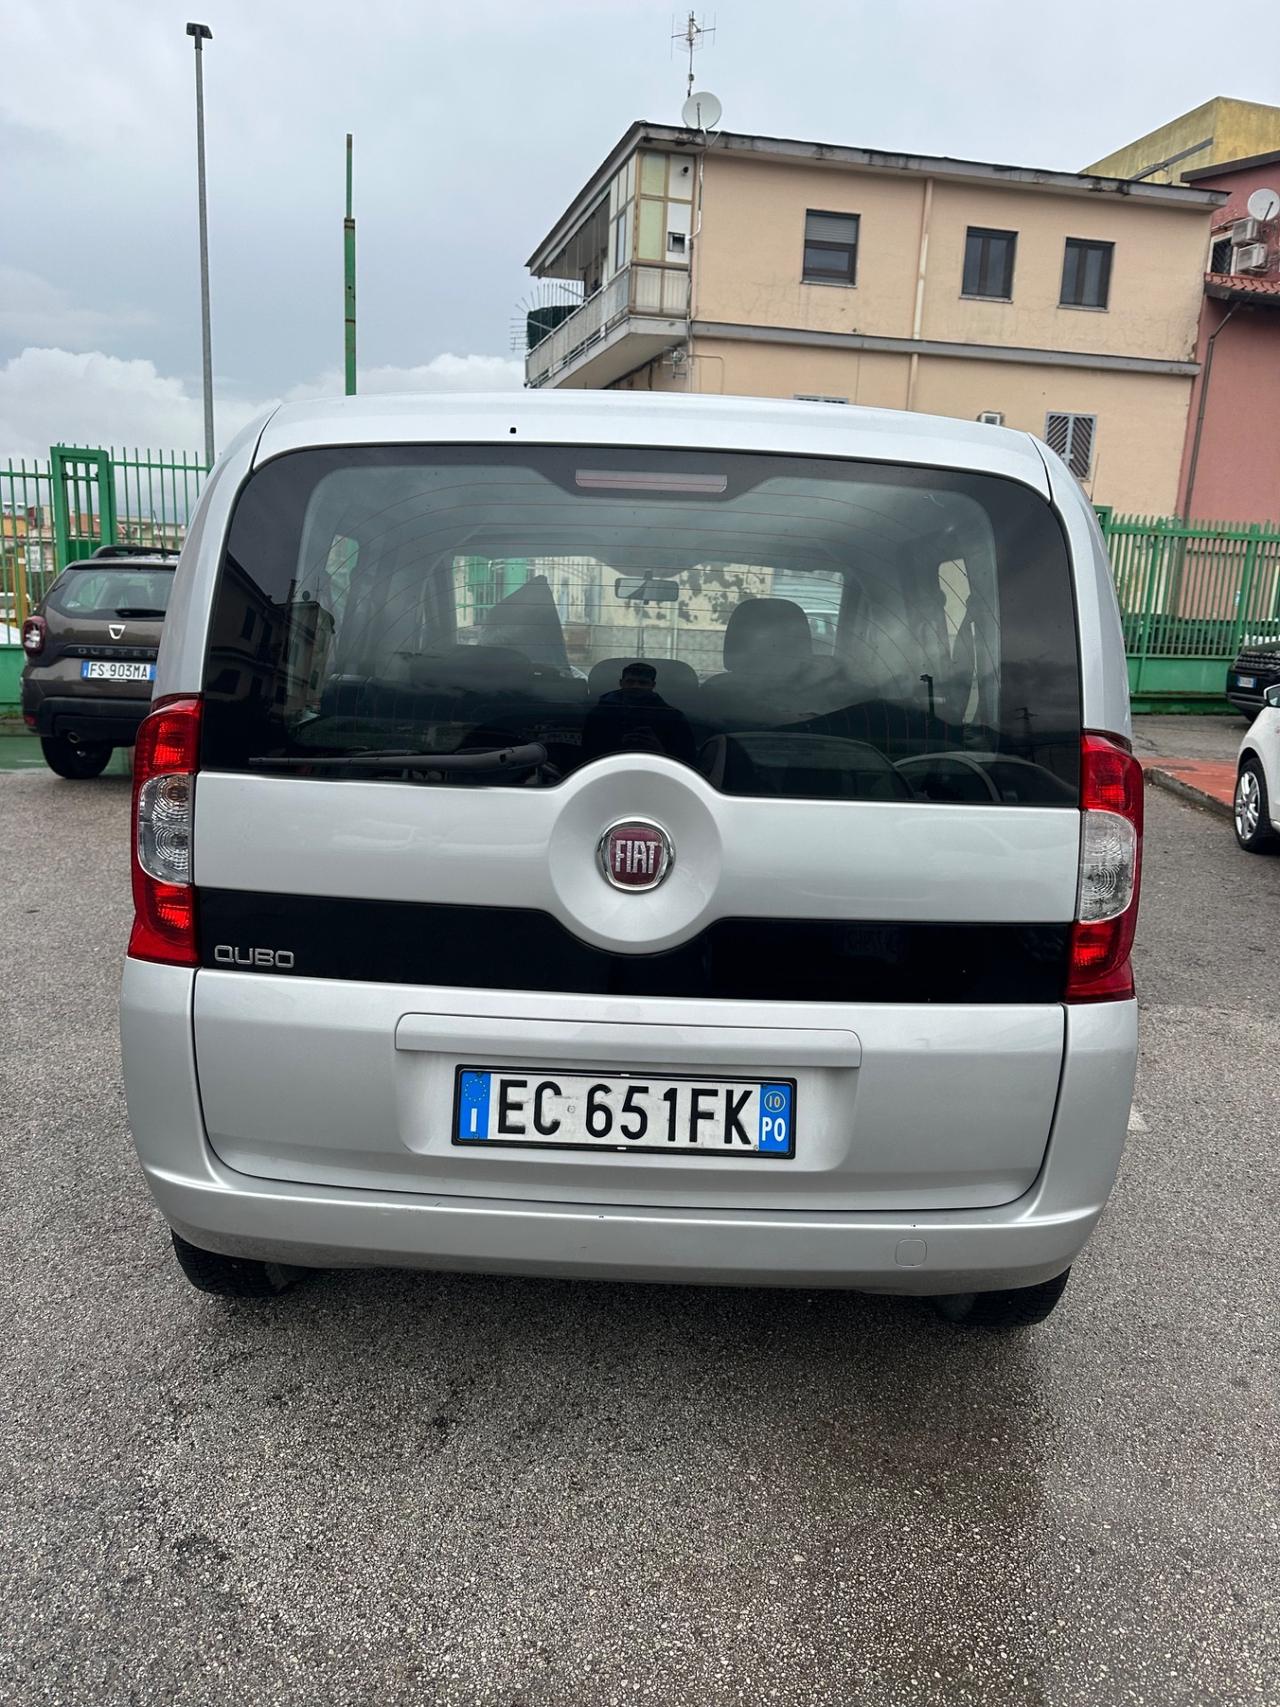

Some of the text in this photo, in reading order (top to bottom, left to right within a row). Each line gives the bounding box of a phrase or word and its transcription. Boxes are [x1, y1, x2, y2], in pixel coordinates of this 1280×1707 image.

[90, 664, 105, 677] FS
[110, 664, 148, 678] 903MA
[615, 839, 659, 873] FIAT
[214, 945, 294, 968] QUBO
[469, 1079, 753, 1144] I EC 651FK
[761, 1116, 787, 1142] PO
